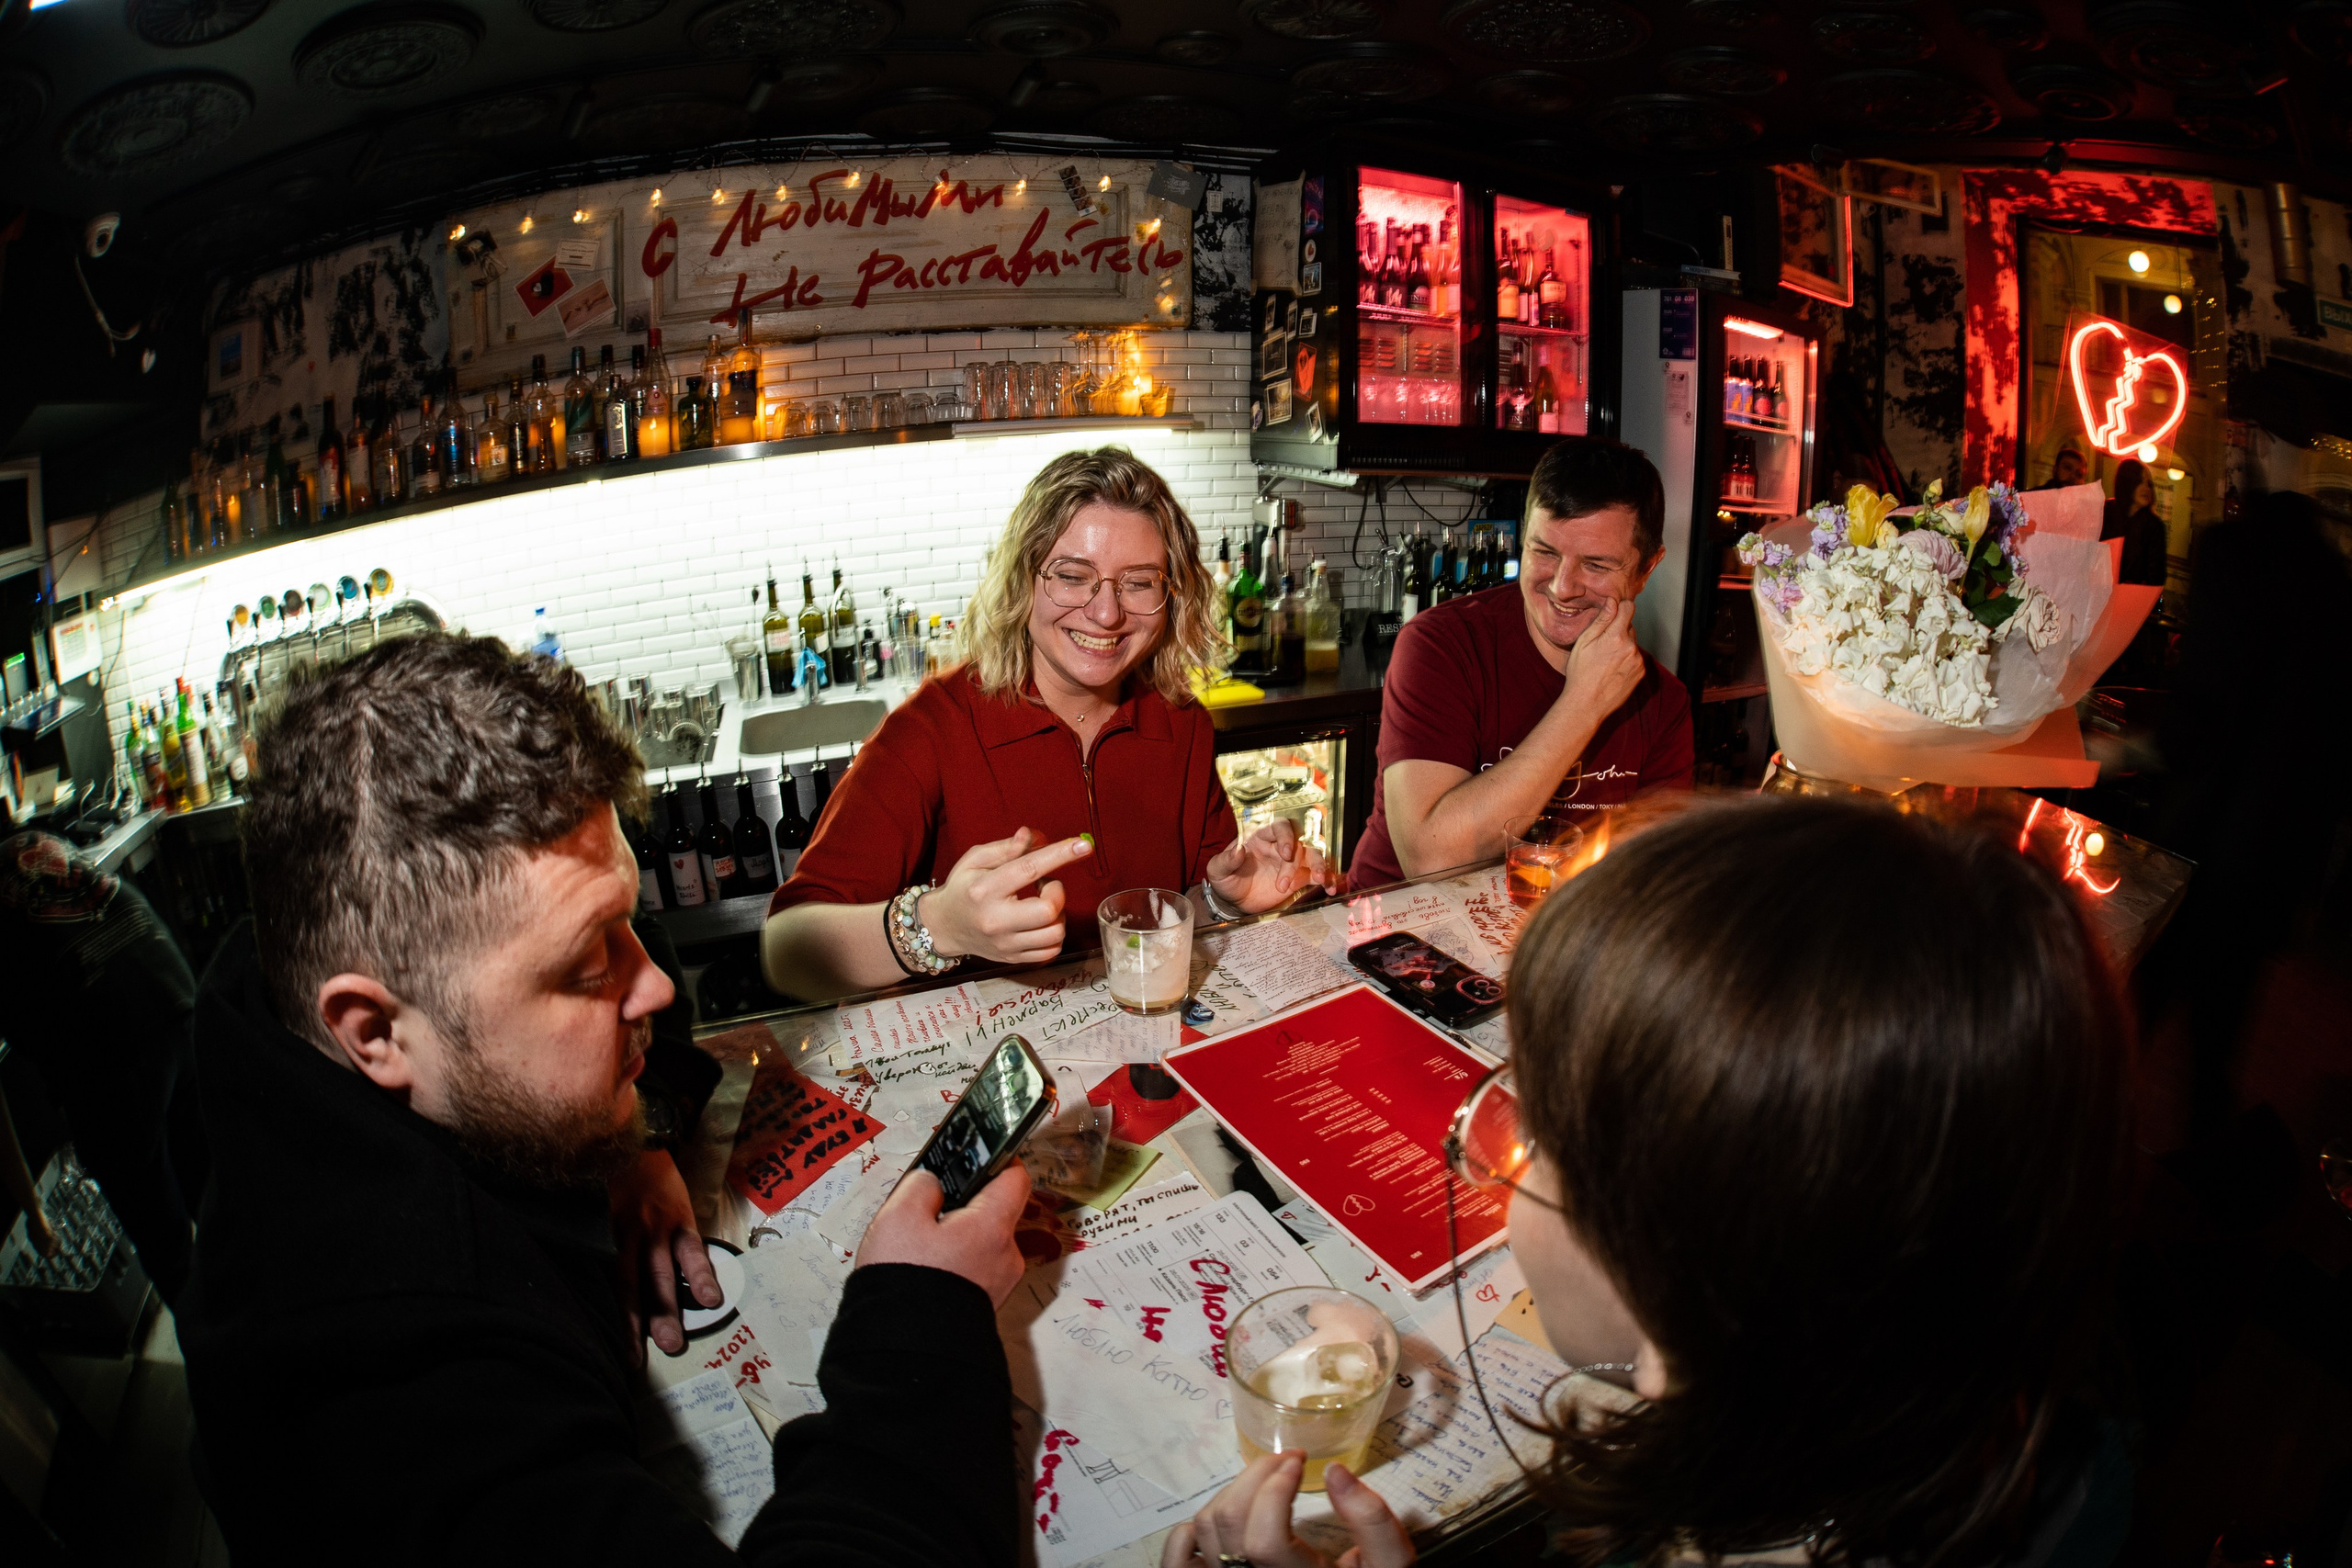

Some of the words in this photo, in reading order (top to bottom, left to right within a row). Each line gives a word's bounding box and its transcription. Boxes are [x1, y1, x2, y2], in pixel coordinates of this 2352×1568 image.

[641, 217, 678, 278] С
[709, 265, 824, 330] Не
[1212, 1211, 1227, 1224] 133
[1238, 1238, 1251, 1248] 03
[1264, 1266, 1281, 1280] 054
[1158, 1270, 1180, 1290] Казань
[1172, 1287, 1191, 1303] Пасс
[1053, 1314, 1135, 1365] Люблю
[1140, 1354, 1210, 1401] Катю
